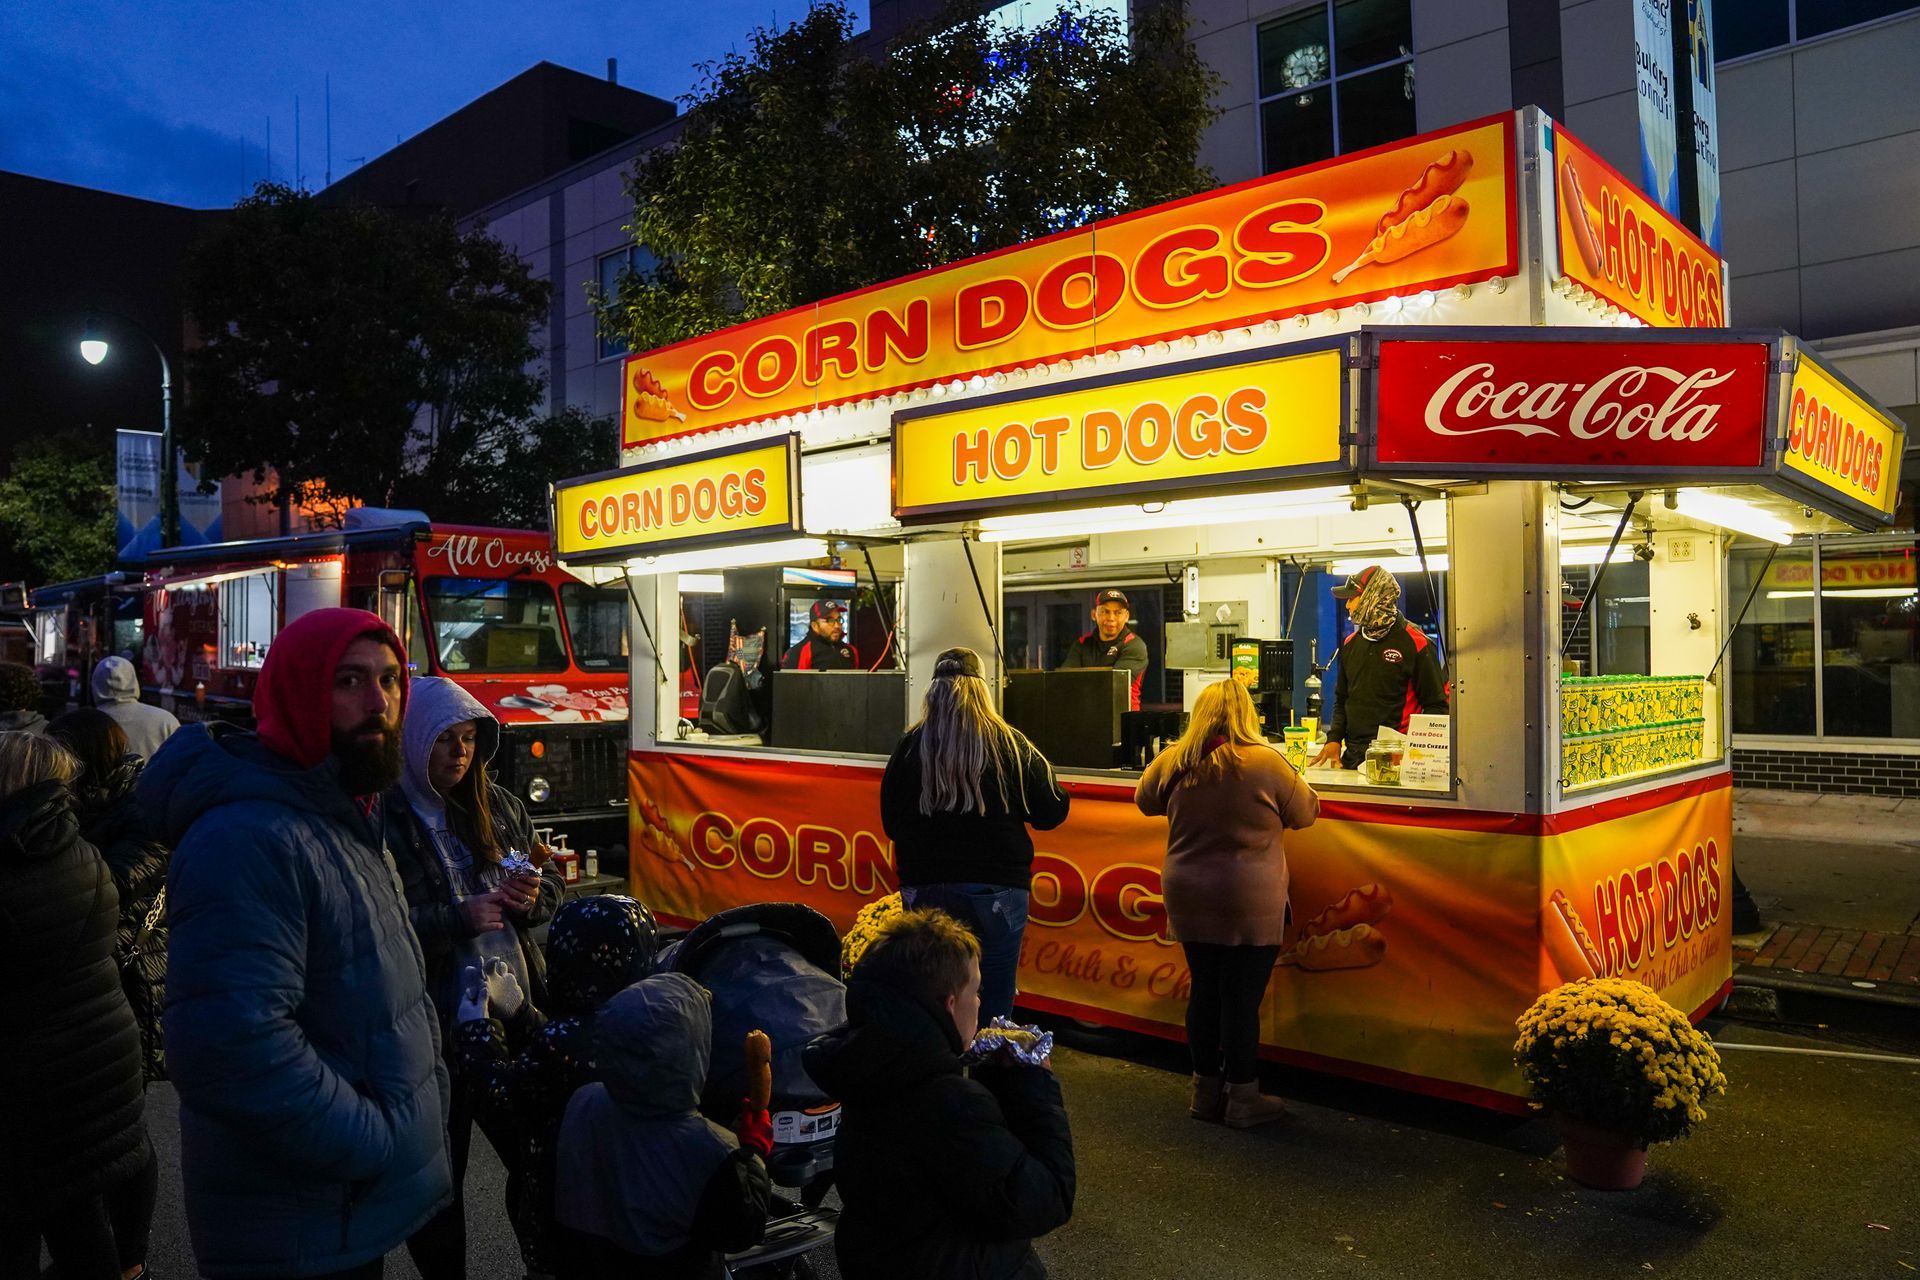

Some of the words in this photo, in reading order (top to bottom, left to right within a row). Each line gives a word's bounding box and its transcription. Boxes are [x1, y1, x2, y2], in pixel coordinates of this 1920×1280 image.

[686, 296, 931, 410] CORN
[954, 198, 1332, 350] DOGS
[1601, 185, 1657, 309] HOT
[1660, 233, 1721, 327] DOGS
[953, 413, 1070, 486] HOT
[1082, 388, 1269, 471] DOGS
[1424, 363, 1737, 442] Coca-Cola
[1789, 387, 1841, 476] CORN
[1840, 416, 1884, 495] DOGS
[579, 487, 664, 540] CORN
[671, 467, 767, 525] DOGS
[427, 534, 480, 575] All
[485, 537, 556, 573] Occasi
[690, 812, 900, 895] CORN
[1029, 852, 1177, 946] OG
[1594, 862, 1656, 978] HOT
[1656, 836, 1721, 948] DOGS
[1035, 940, 1105, 983] Chili
[1110, 955, 1138, 989] &
[1147, 962, 1192, 1001] Ch
[1668, 953, 1689, 985] Chili
